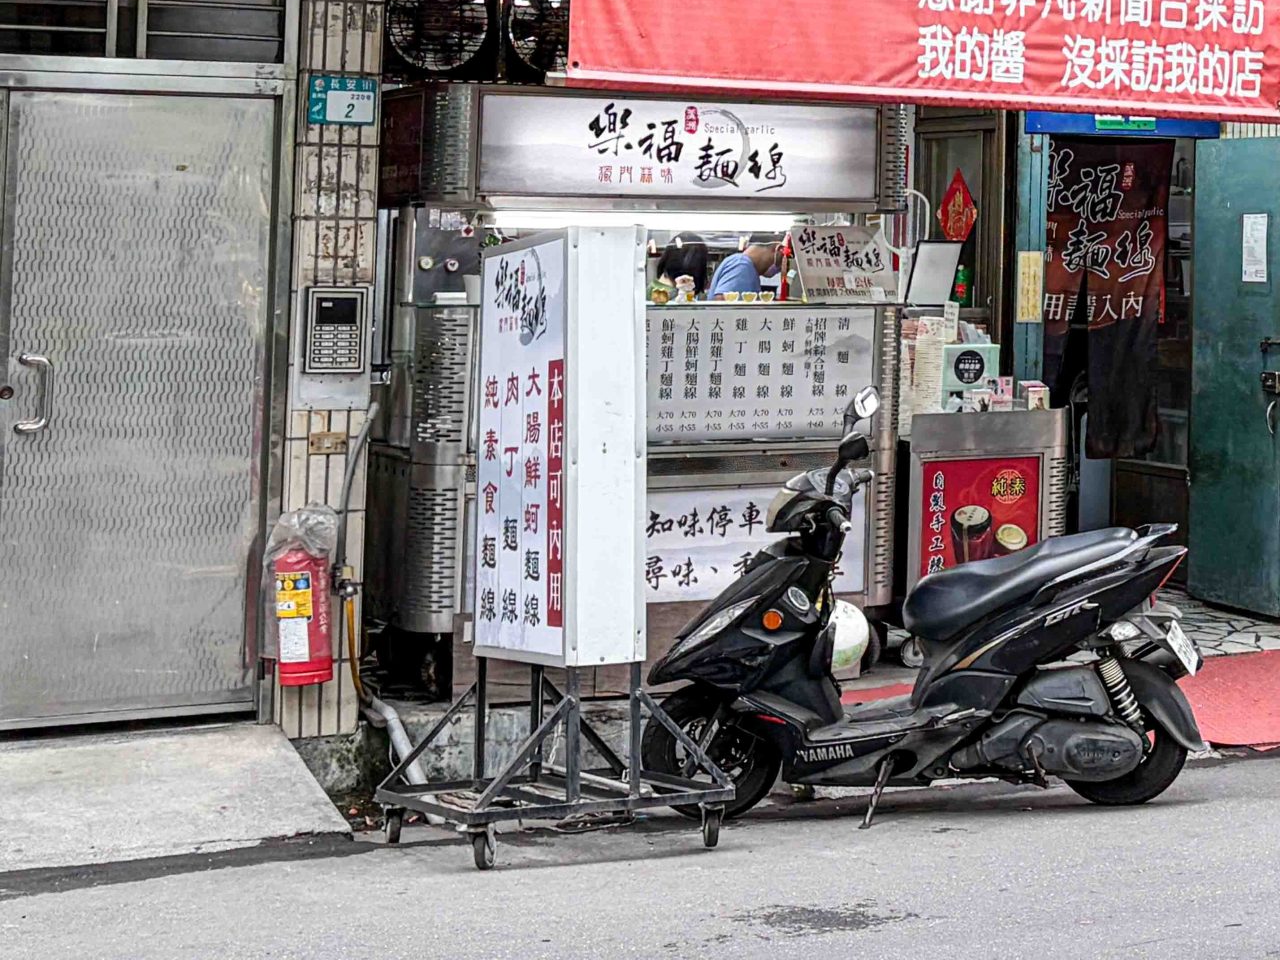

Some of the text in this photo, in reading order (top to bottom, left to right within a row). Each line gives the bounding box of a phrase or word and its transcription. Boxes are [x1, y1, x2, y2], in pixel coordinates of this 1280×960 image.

[917, 24, 1263, 100] 我的醬 沒採訪我的店
[344, 103, 355, 118] 2
[704, 122, 739, 135] Special
[827, 276, 873, 288] 每週公休
[479, 375, 499, 622] 純素食麵線
[501, 371, 519, 624] 肉丁麵線
[523, 367, 541, 627] 大腸鮮蚵麵線
[548, 368, 563, 611] 本店可內用
[992, 477, 1025, 497] 純素
[646, 502, 763, 538] 知味停車
[801, 743, 854, 763] YAMAHA
